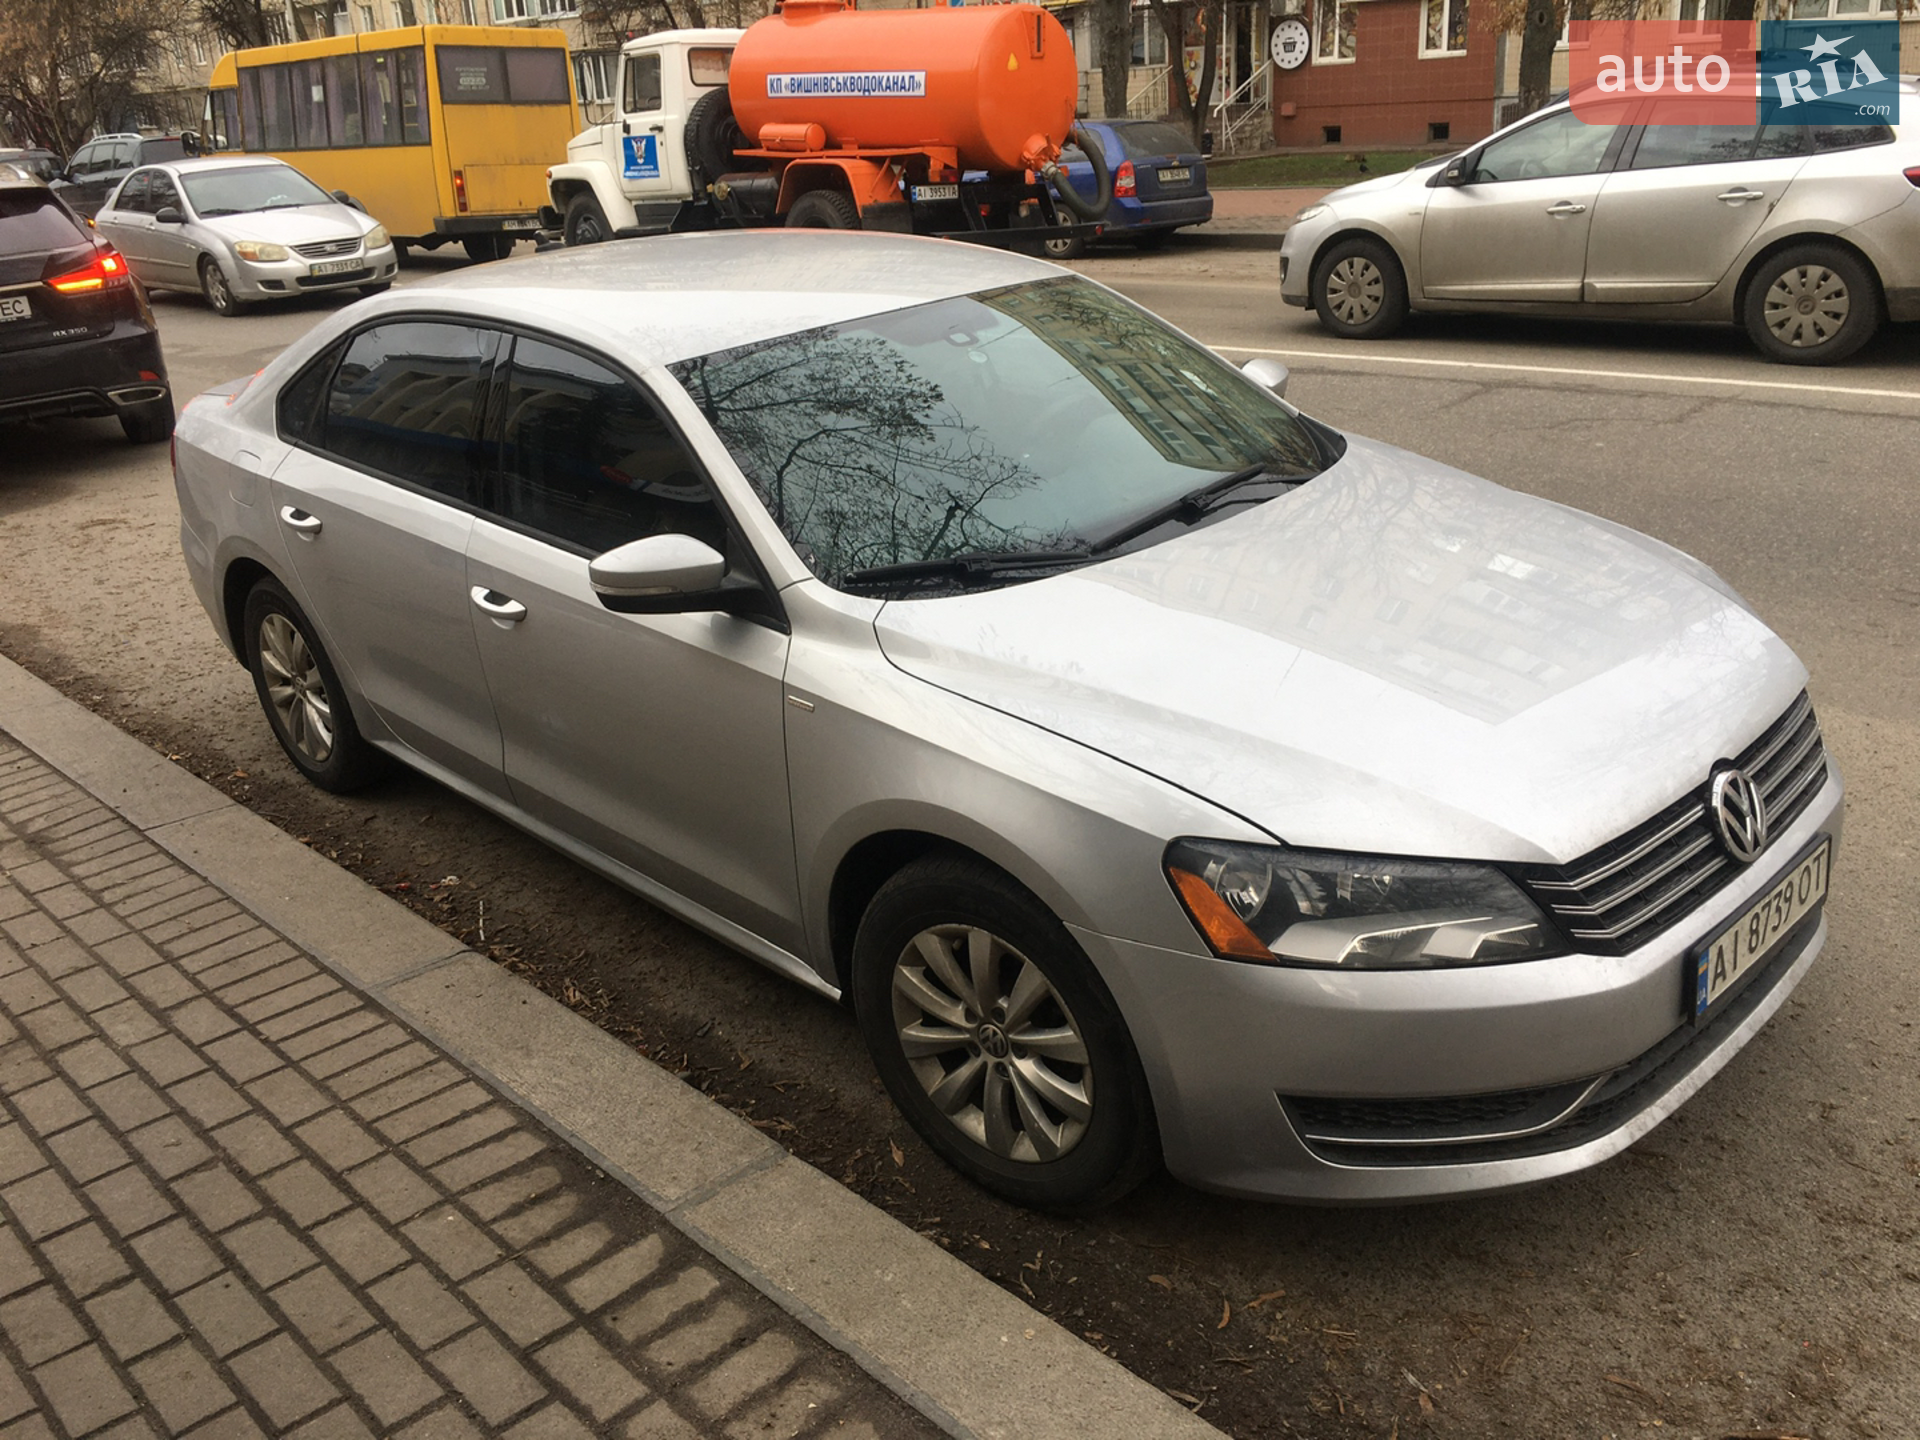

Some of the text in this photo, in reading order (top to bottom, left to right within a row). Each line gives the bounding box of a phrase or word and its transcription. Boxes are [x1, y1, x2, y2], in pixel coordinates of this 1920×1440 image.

[769, 75, 922, 96] КП «ВИШНІВСЬКВОДОКАНАЛ»
[929, 187, 947, 198] 3953
[1711, 847, 1826, 993] AI 8739 OT
